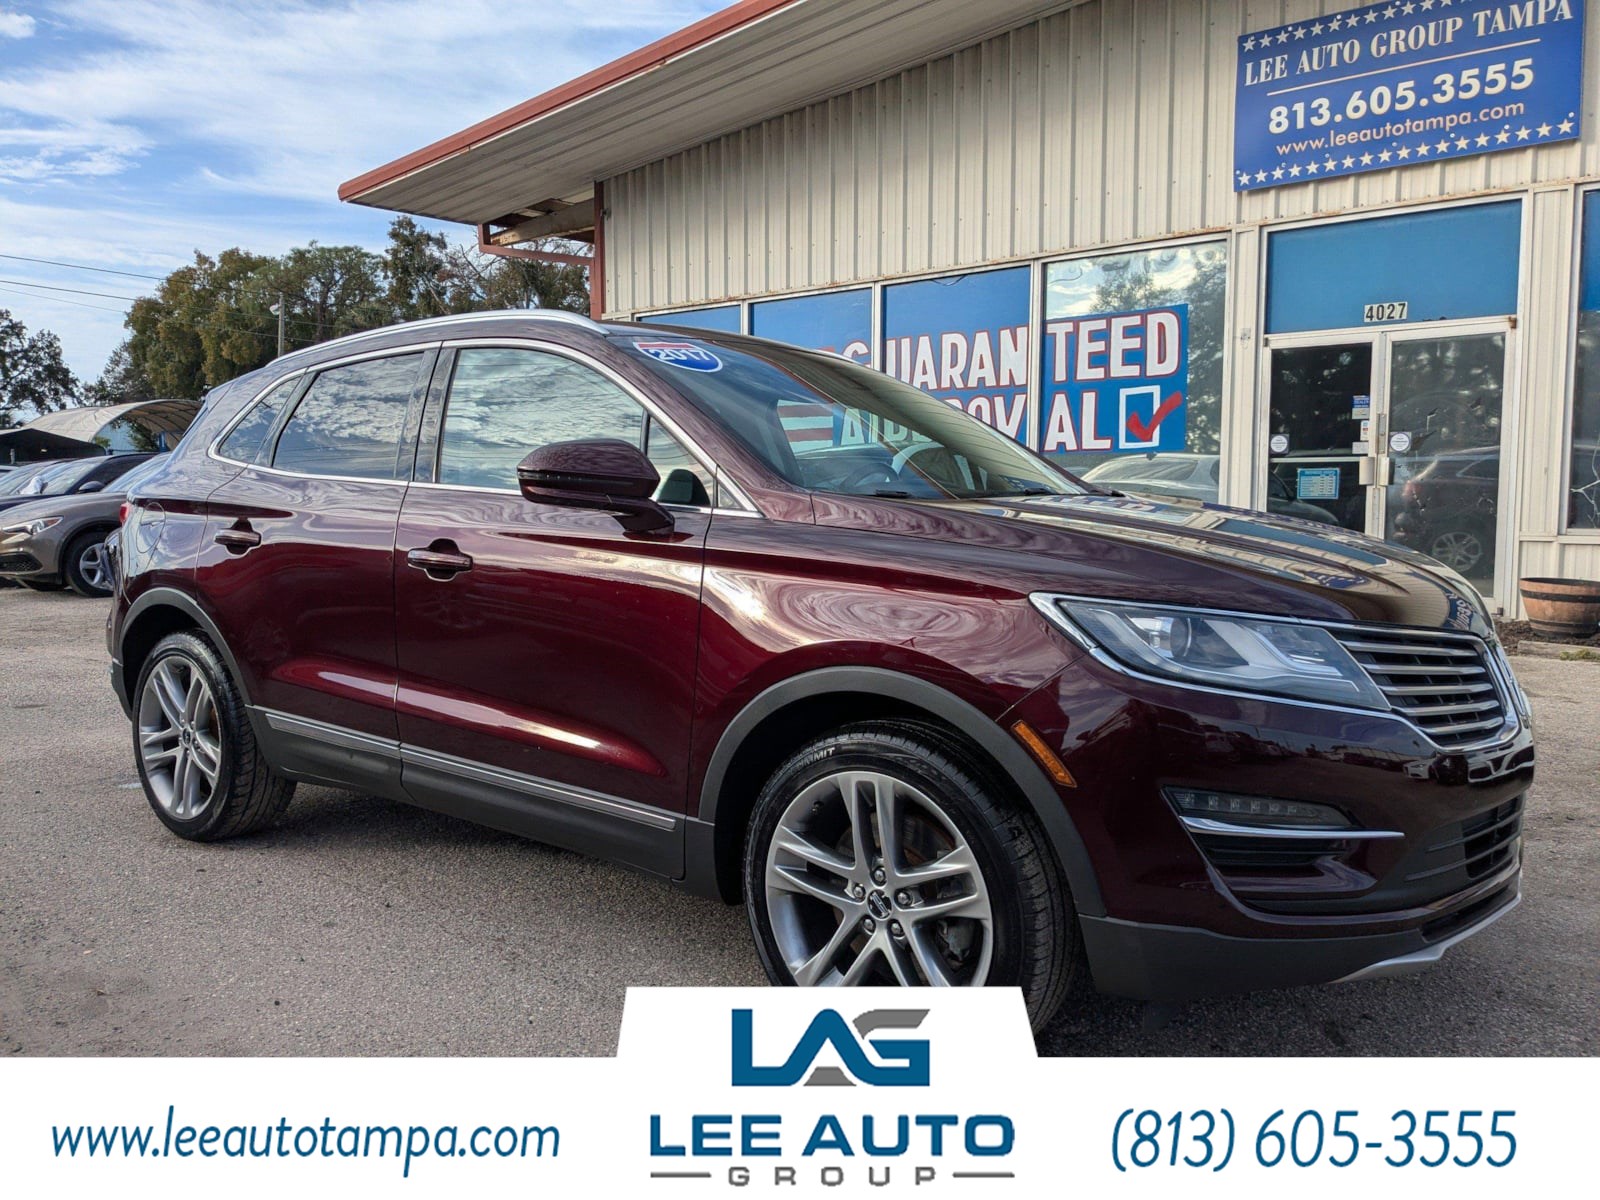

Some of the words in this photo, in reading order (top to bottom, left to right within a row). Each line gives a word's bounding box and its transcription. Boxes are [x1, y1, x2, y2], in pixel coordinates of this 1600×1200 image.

[1244, 54, 1288, 86] LEE
[1296, 39, 1361, 75] AUTO
[1370, 17, 1463, 58] GROUP
[1473, 0, 1574, 37] TAMPA
[1268, 58, 1535, 134] 813.605.3555
[1276, 102, 1525, 156] www.leeautotampa.com
[1366, 303, 1406, 321] 4027
[648, 348, 710, 361] 2017
[840, 391, 1112, 452] AOVAL
